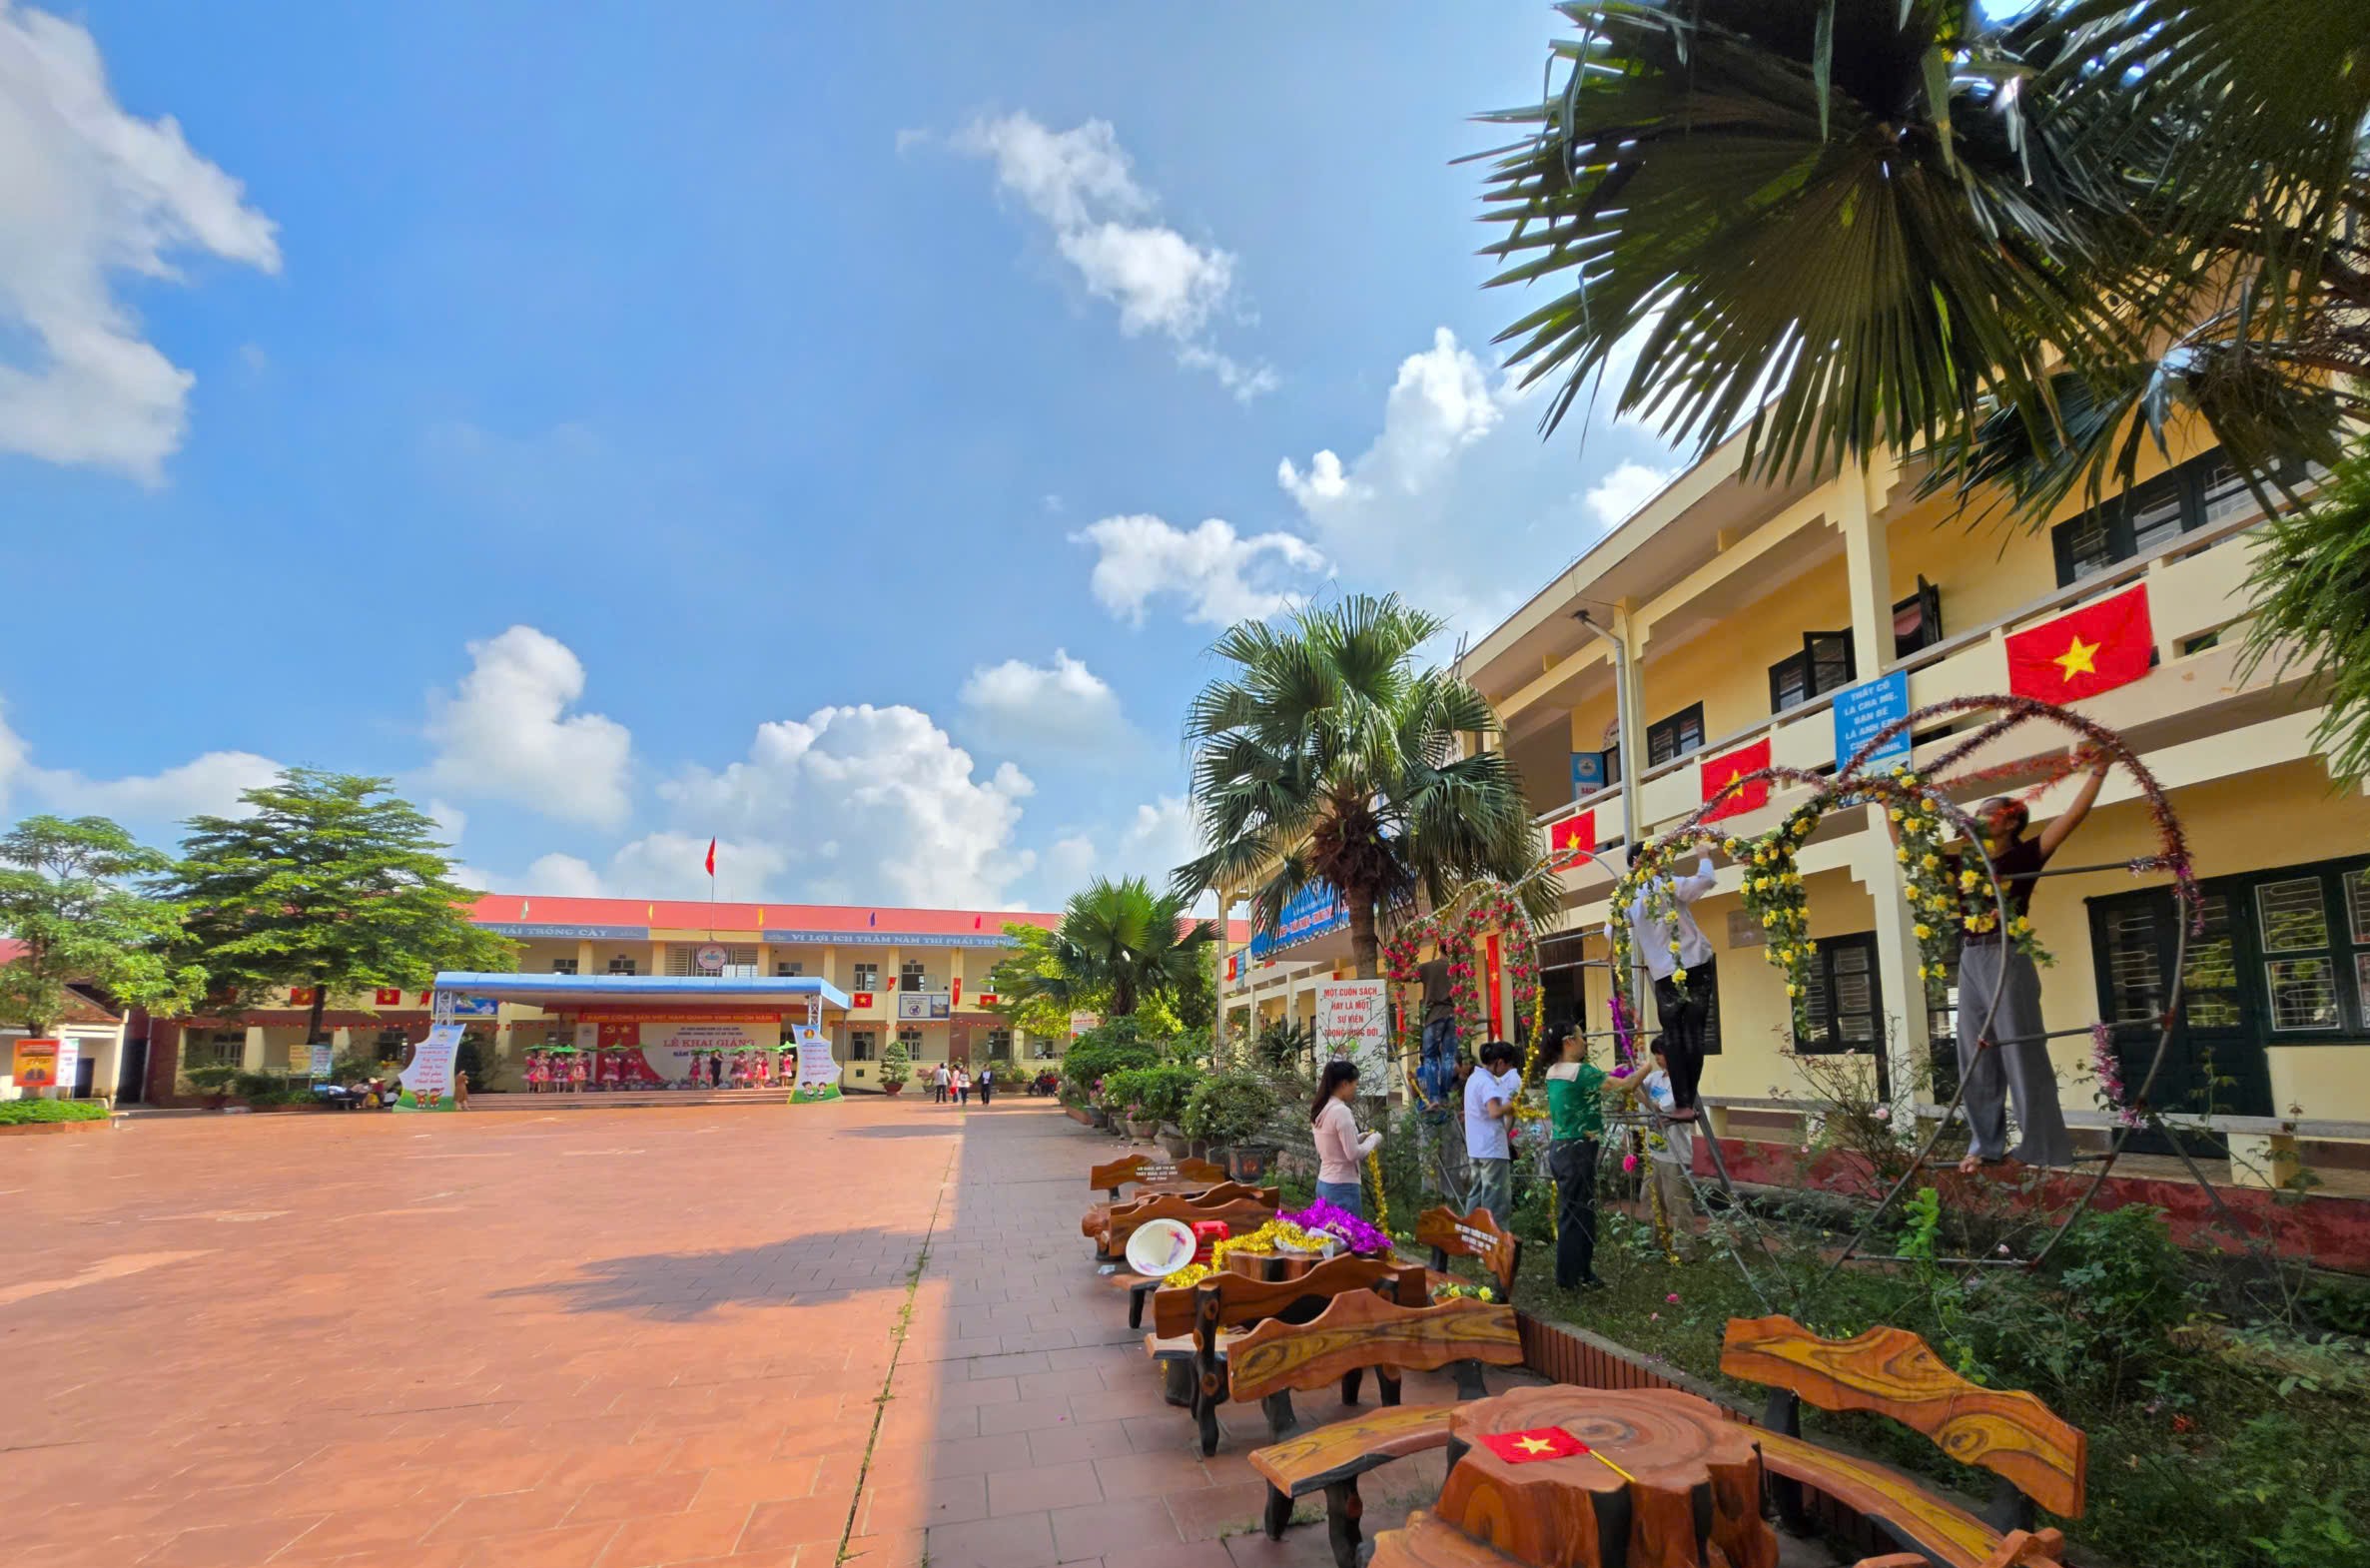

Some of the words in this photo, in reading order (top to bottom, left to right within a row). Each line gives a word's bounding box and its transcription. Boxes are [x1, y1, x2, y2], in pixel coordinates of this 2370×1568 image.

[1324, 987, 1337, 997] MỘT
[1339, 986, 1357, 997] CUỐN
[1359, 986, 1377, 996] SÁCH
[1345, 1001, 1353, 1010] LÀ
[1355, 1001, 1369, 1011] MỘT
[682, 1038, 712, 1047] KHAI
